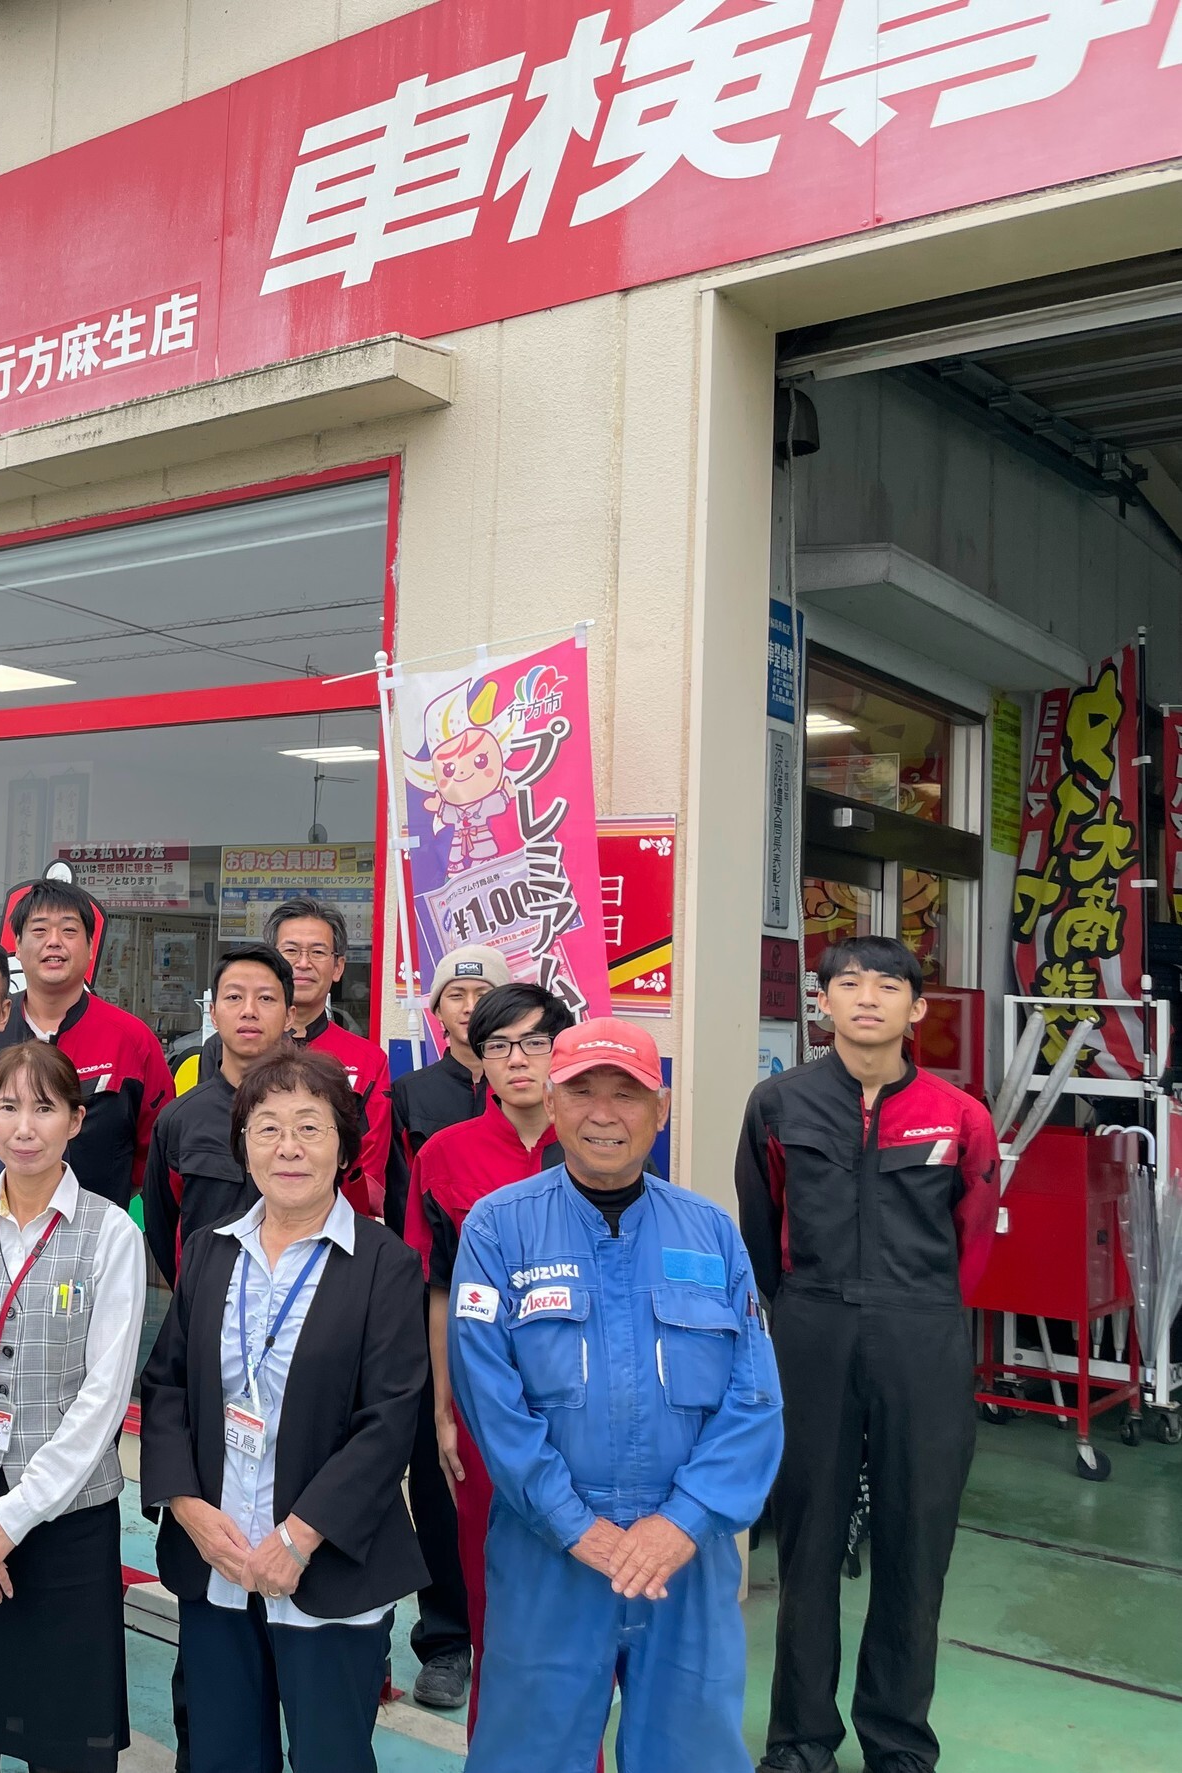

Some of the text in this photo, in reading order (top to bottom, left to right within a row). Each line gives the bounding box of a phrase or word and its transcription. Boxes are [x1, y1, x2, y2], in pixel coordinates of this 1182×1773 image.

[507, 692, 562, 722] 行方市
[69, 841, 165, 860] お支払い方法
[225, 849, 336, 872] お得な会員制度
[460, 1304, 489, 1315] SUZUKI
[522, 1294, 568, 1315] ARENA
[226, 1427, 256, 1453] 白鳥
